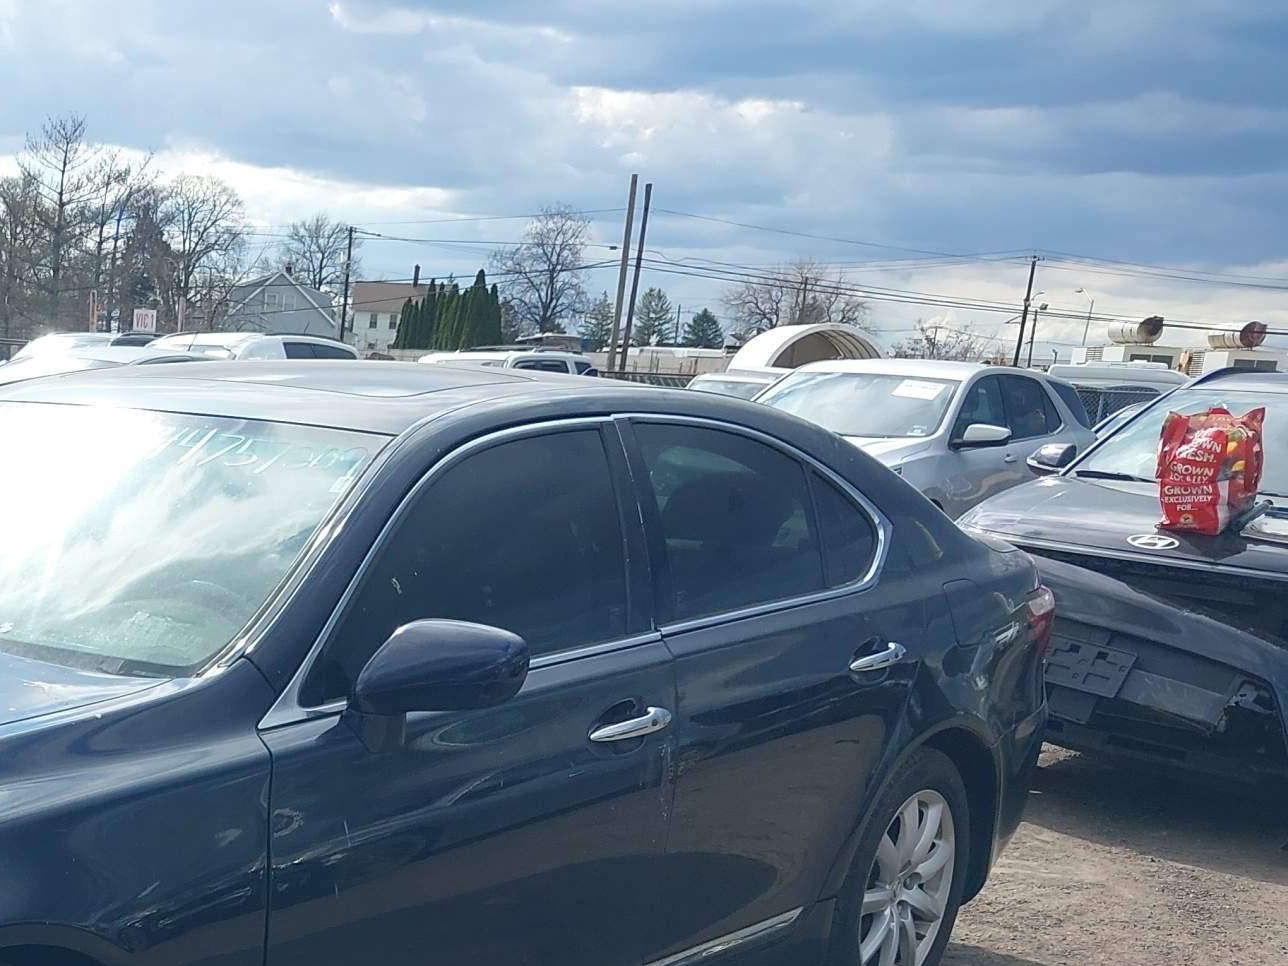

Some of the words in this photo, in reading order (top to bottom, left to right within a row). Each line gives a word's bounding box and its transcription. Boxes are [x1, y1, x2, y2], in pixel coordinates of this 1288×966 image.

[135, 312, 148, 328] VIC
[1170, 461, 1214, 477] GROWN
[1164, 484, 1213, 495] GROWN
[1164, 495, 1213, 503] EXCLUSIVELY
